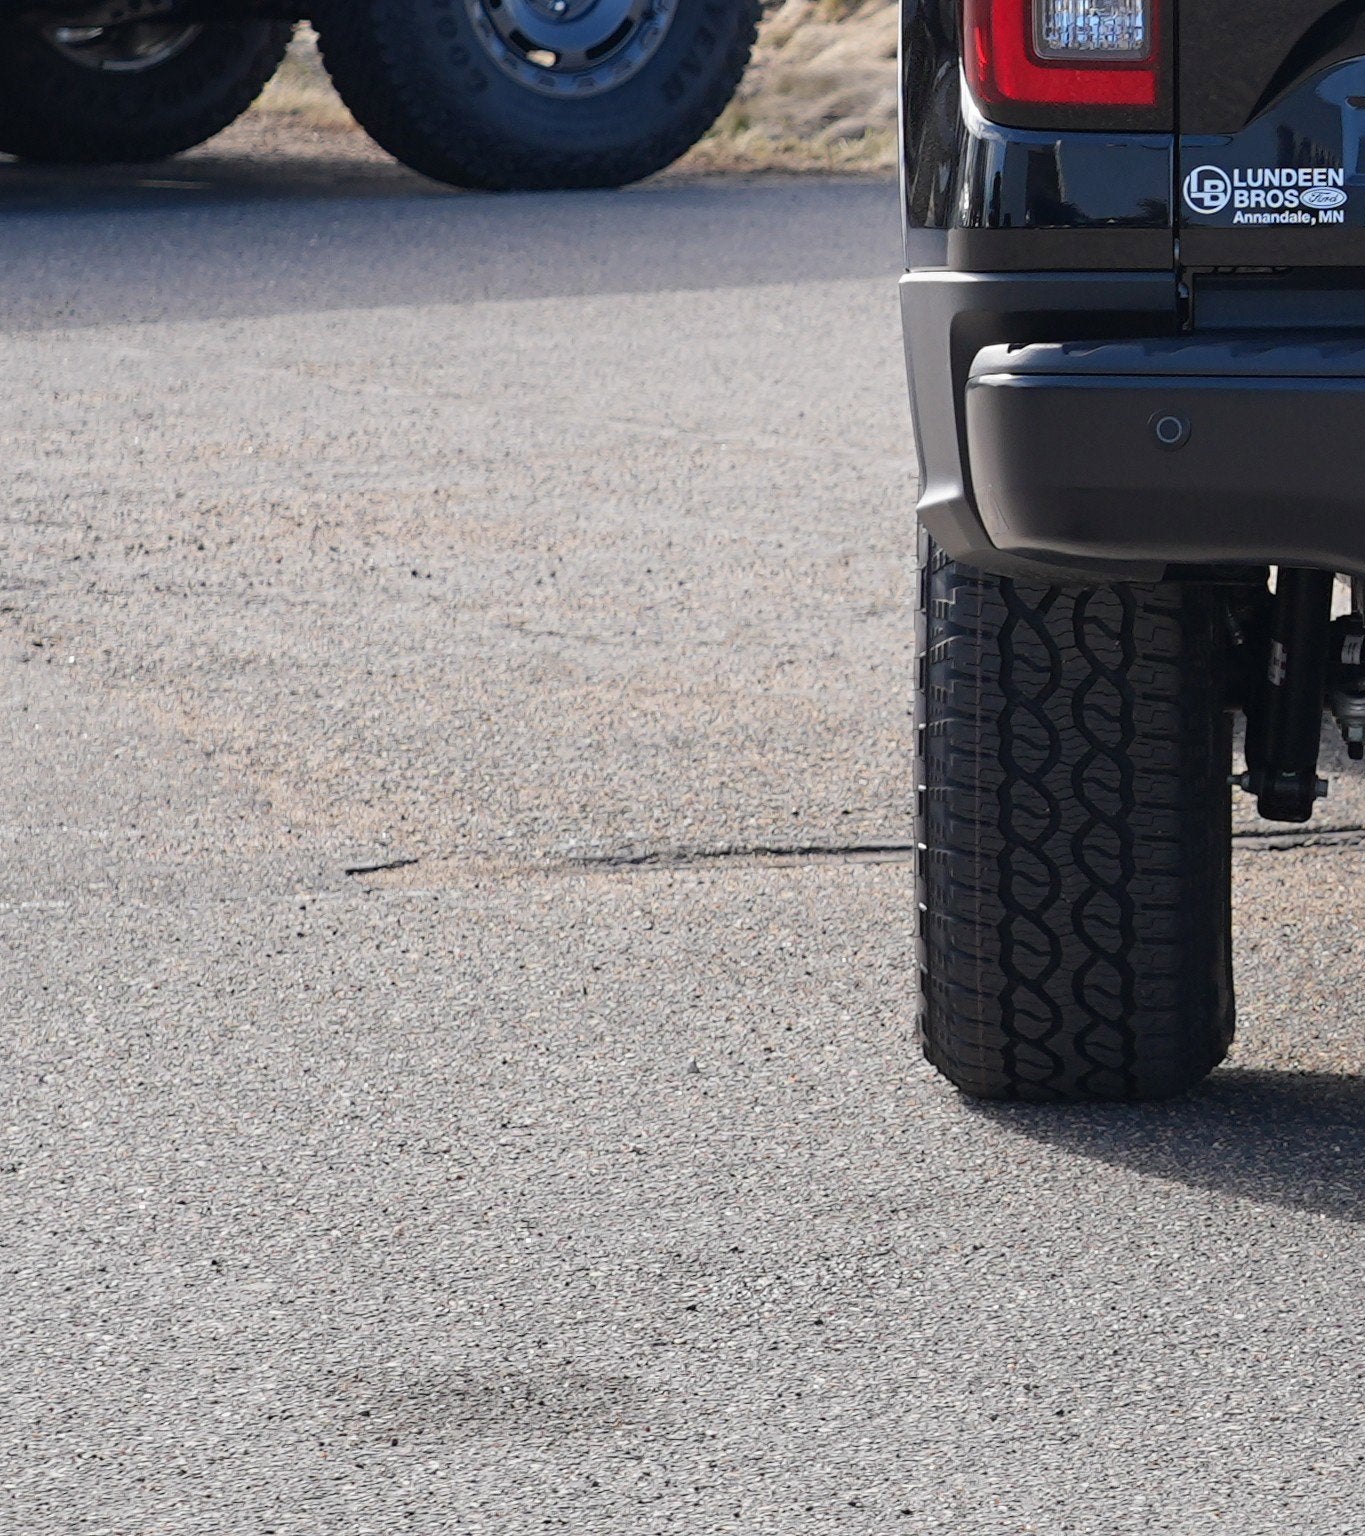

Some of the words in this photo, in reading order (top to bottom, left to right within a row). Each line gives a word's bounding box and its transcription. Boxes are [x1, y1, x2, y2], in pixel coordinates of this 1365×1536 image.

[1233, 168, 1344, 187] LUNDEEN
[1233, 189, 1299, 208] BROS
[1232, 210, 1316, 225] Annandale,
[1318, 210, 1344, 223] MN
